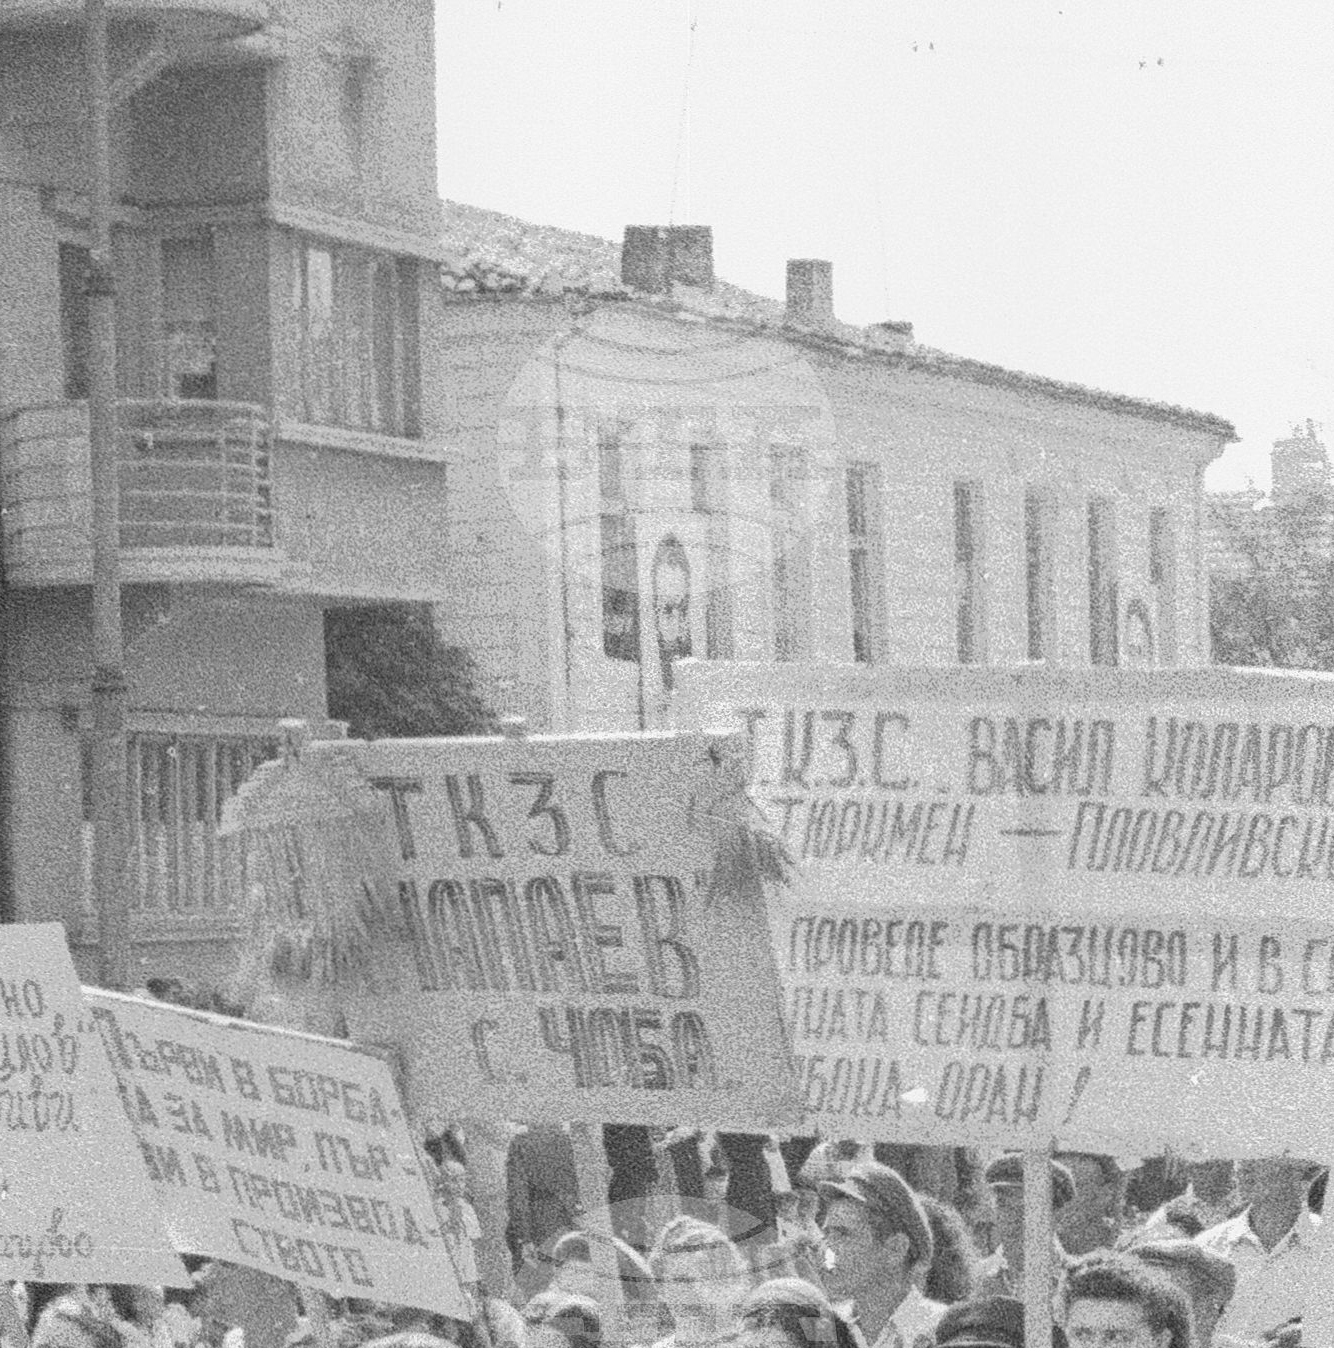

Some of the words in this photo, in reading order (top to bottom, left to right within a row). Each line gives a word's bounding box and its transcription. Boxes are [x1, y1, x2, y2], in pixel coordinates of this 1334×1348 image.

[789, 914, 950, 981] ПРОВЕДЕ
[970, 921, 1188, 990] ОБРАЗЦОВО
[1209, 931, 1238, 995] И
[1258, 933, 1283, 996] В
[1078, 997, 1104, 1051] И
[229, 1056, 263, 1102] В
[191, 1151, 222, 1195] В
